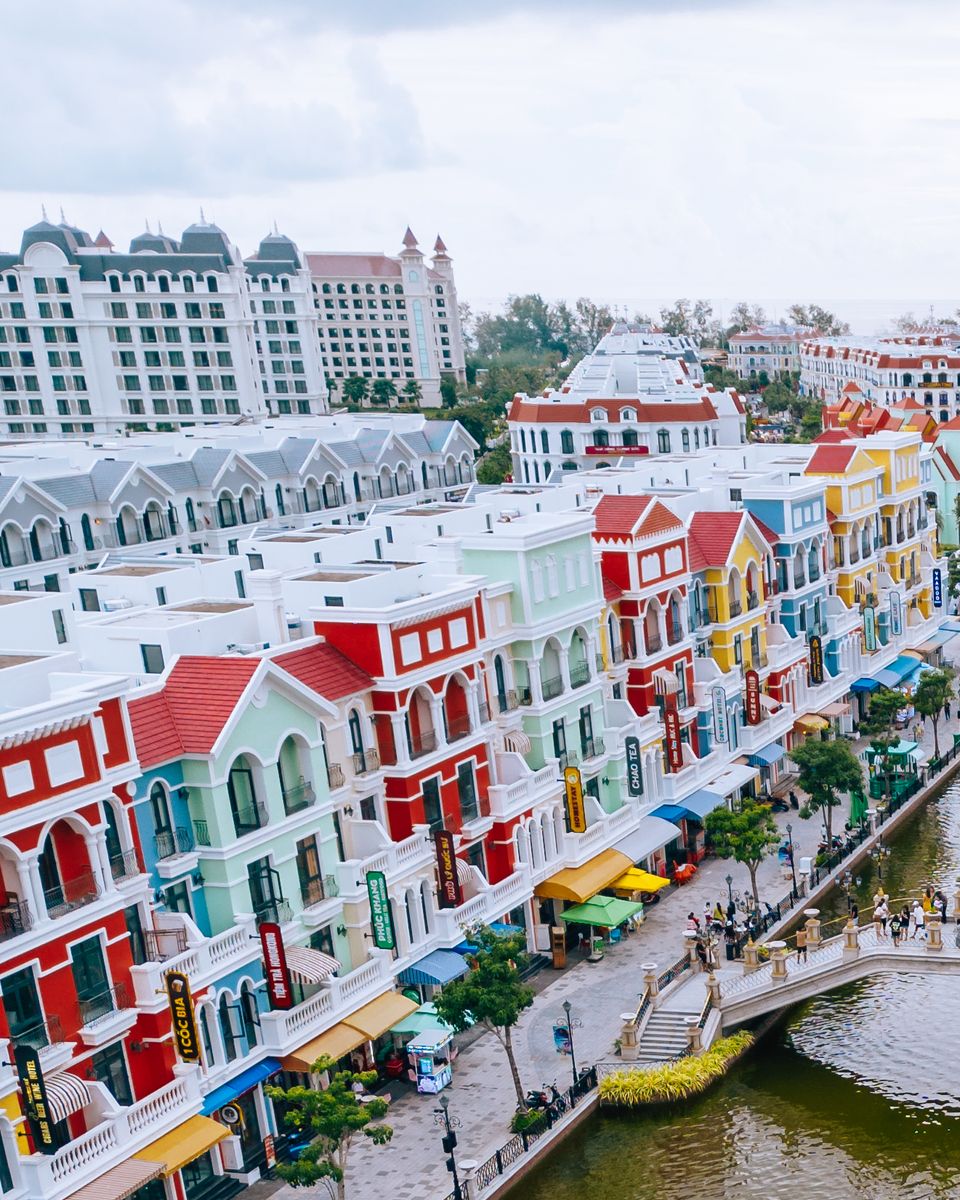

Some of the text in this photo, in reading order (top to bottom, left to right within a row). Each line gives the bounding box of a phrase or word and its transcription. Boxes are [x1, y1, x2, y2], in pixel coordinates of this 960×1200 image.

[628, 743, 640, 789] CHAO TEA
[571, 786, 581, 828] HOMESTAY
[369, 879, 386, 942] PHÚC KHANG
[270, 968, 284, 982] TRÀ
[174, 997, 187, 1018] BIA
[176, 1020, 191, 1047] CỐC
[26, 1060, 38, 1080] HOTEL
[31, 1083, 42, 1100] WINE
